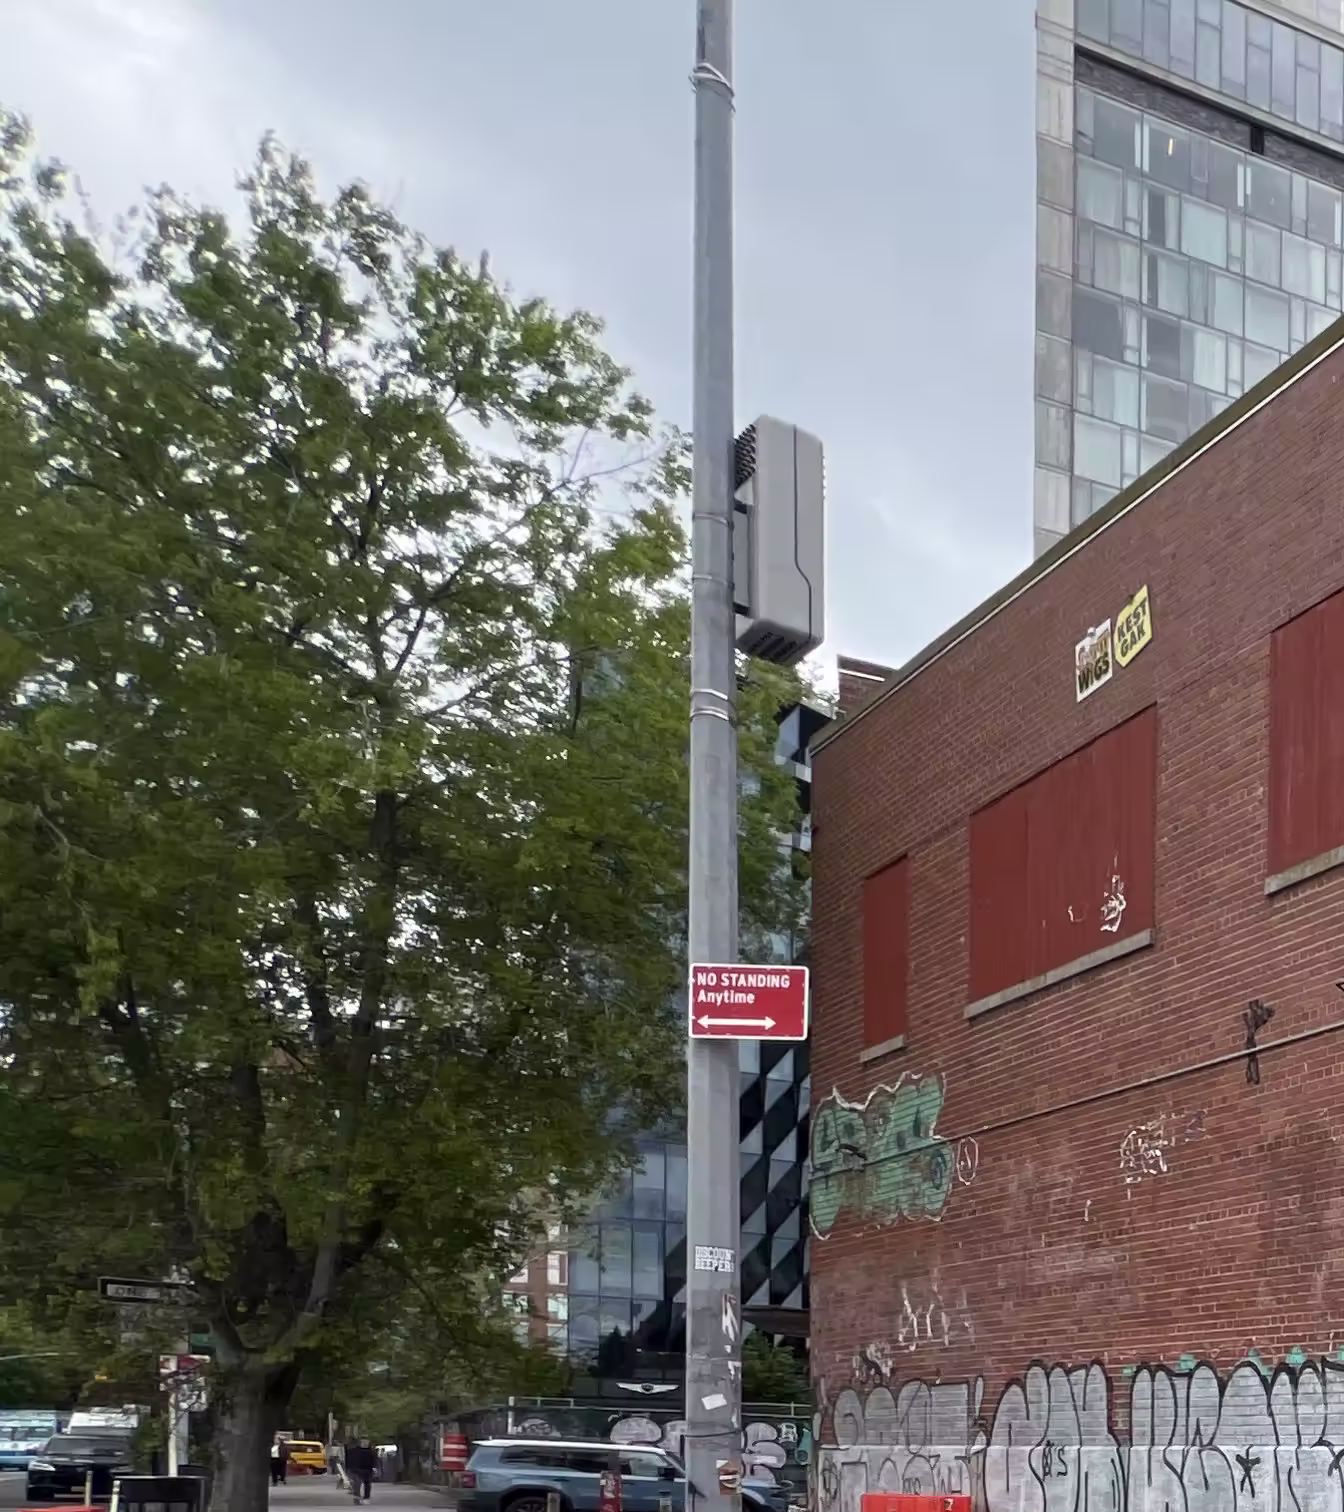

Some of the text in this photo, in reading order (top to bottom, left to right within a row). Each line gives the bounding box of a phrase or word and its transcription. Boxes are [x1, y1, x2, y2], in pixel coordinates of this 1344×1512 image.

[1119, 597, 1147, 640] KEST
[1120, 620, 1146, 657] GAK
[696, 972, 790, 989] NO STANDING
[697, 989, 756, 1006] Anytime
